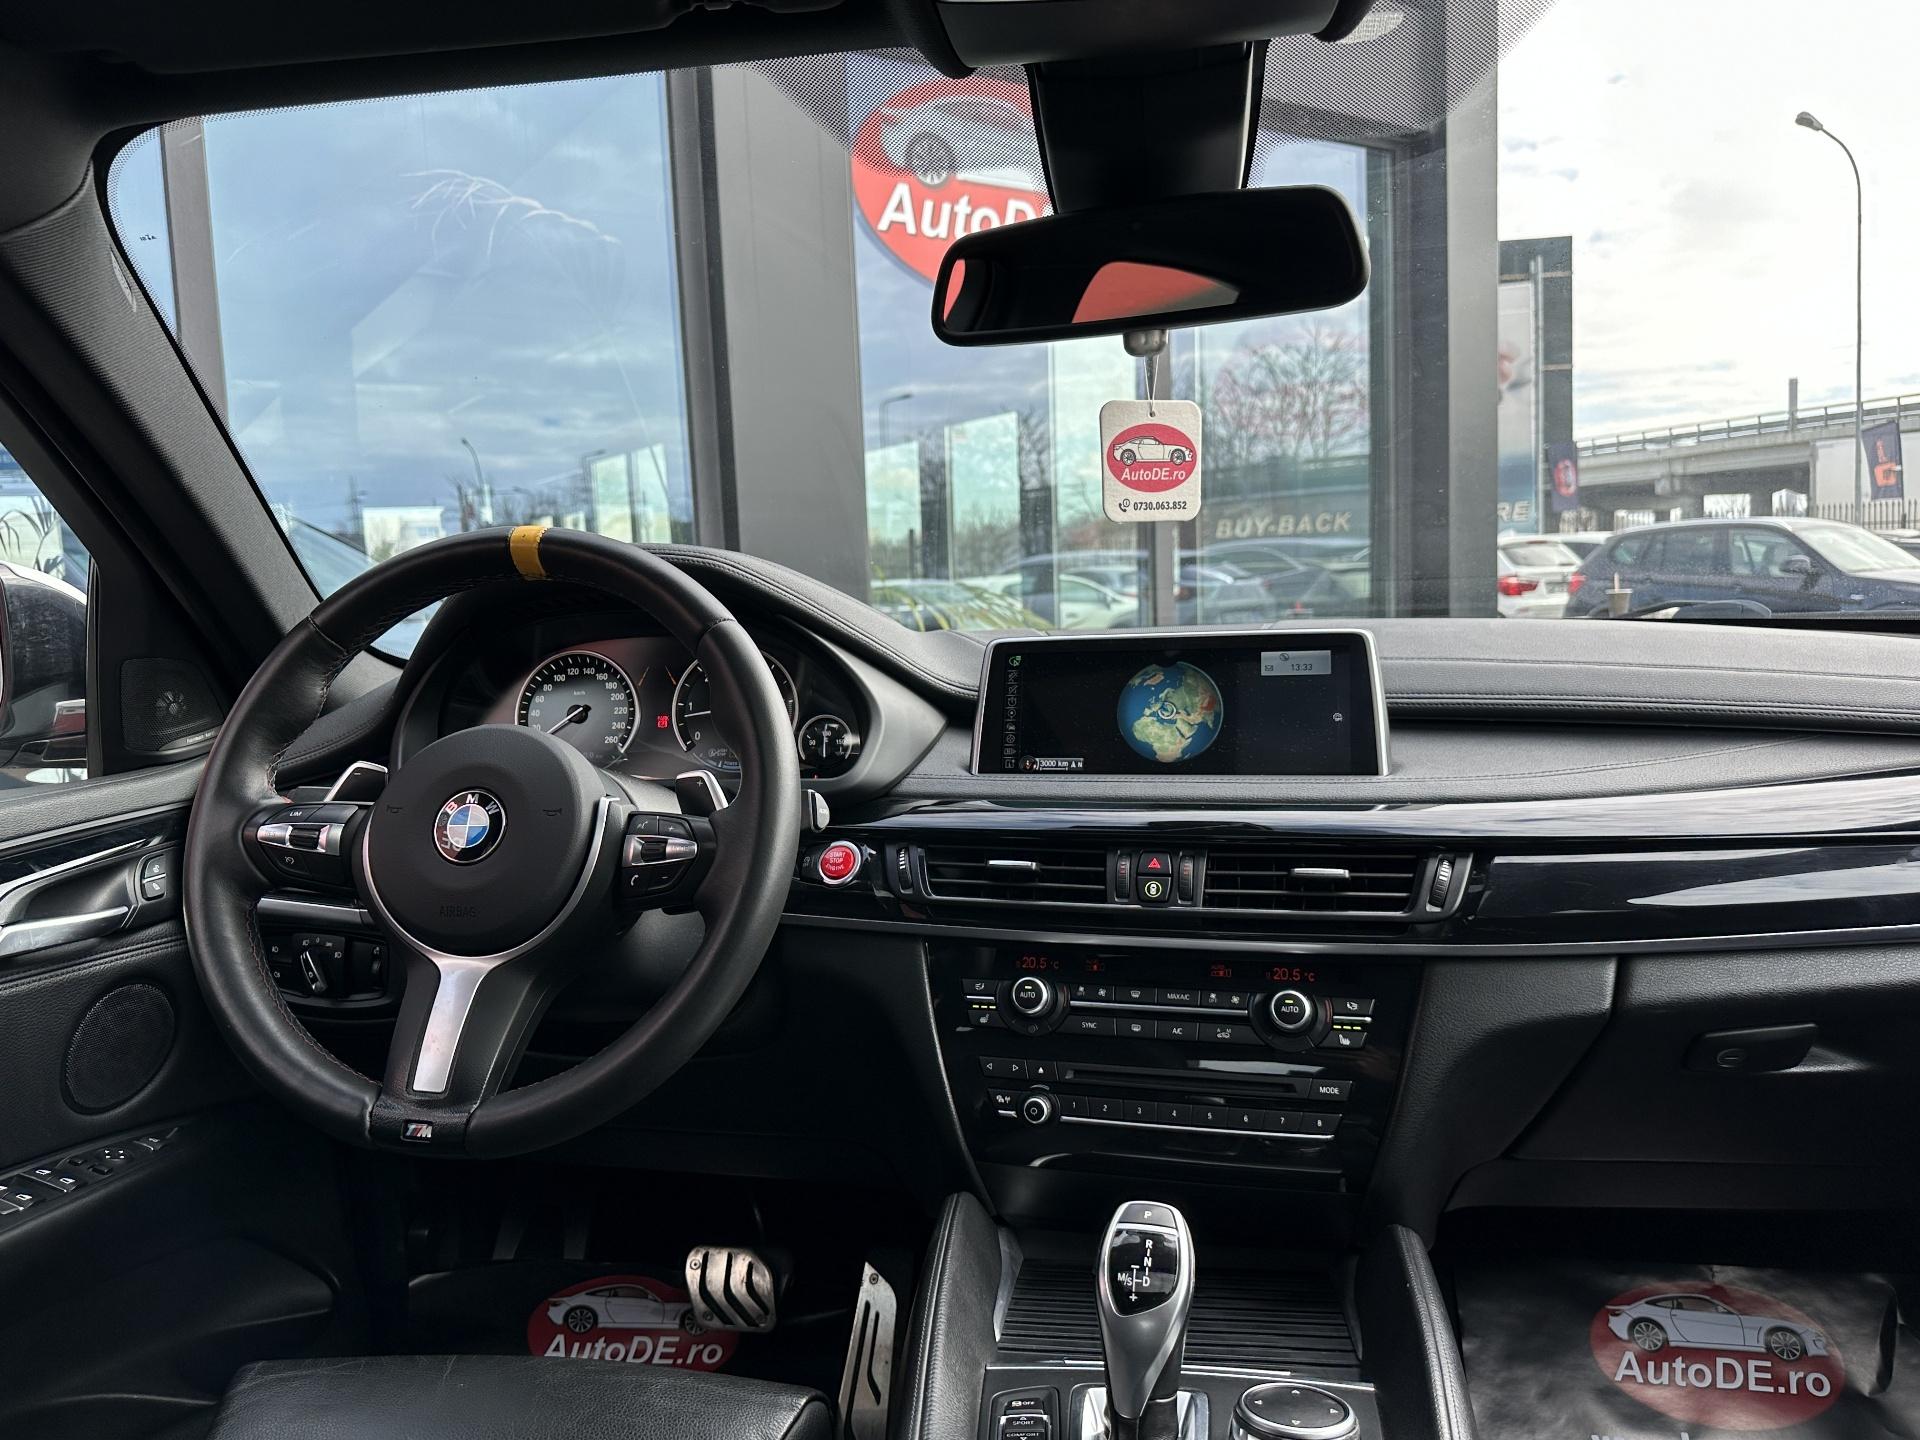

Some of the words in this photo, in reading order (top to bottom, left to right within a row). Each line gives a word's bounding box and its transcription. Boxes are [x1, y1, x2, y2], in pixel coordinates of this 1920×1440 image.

[877, 182, 1053, 239] AutoD
[1121, 468, 1186, 481] AutoDE.ro
[1133, 501, 1187, 511] 0730.063.852
[1215, 512, 1352, 539] BUY-BACK
[583, 667, 595, 675] 140
[1291, 663, 1313, 671] 13:33
[554, 674, 566, 682] 100
[596, 672, 608, 681] 160
[543, 684, 552, 692] 80
[605, 682, 617, 690] 180
[611, 693, 624, 701] 200
[531, 709, 540, 717] 40
[614, 706, 628, 714] 220
[612, 721, 626, 730] 240
[604, 735, 619, 744] 260
[694, 731, 701, 741] 0
[445, 793, 500, 815] BMW
[440, 904, 477, 918] AIRBAG
[1273, 967, 1301, 981] 20.5
[1020, 991, 1036, 999] AUTO
[1281, 1005, 1299, 1014] AUTO
[1081, 1021, 1097, 1029] SYNC
[1172, 1027, 1183, 1035] A/C
[1319, 1086, 1340, 1095] MODE
[1072, 1101, 1076, 1109] 1
[1102, 1104, 1108, 1112] 2
[1137, 1107, 1142, 1115] 3
[1171, 1109, 1177, 1117] 4
[1207, 1112, 1212, 1120] 5
[1243, 1114, 1249, 1123] 6
[1280, 1117, 1285, 1125] 7
[1317, 1119, 1322, 1127] 8
[1143, 1210, 1152, 1219] P
[1145, 1239, 1153, 1249] R
[1143, 1256, 1152, 1267] N
[1142, 1276, 1151, 1287] D
[544, 1333, 724, 1365] AutoDE.ro
[1614, 1351, 1832, 1397] AutoDE.ro
